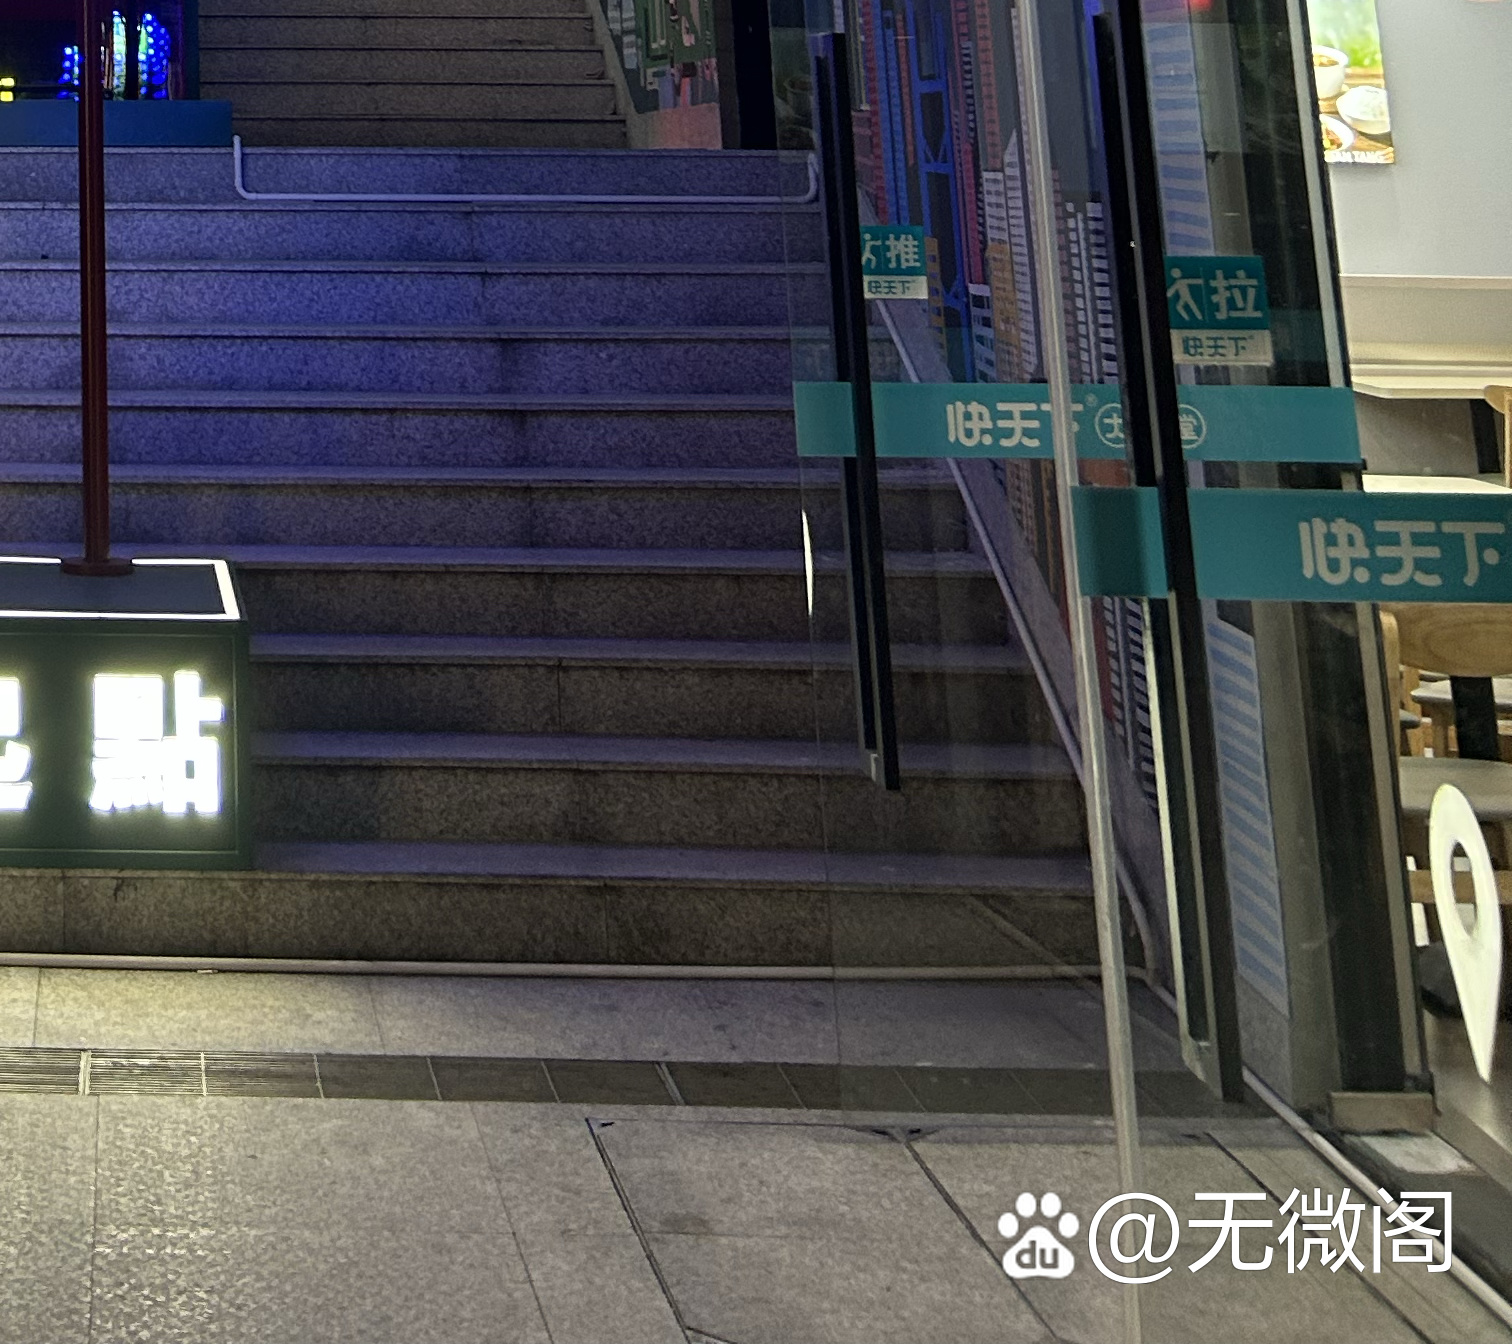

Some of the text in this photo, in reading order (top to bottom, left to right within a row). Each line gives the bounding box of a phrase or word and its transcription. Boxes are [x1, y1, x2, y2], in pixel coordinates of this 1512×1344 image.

[886, 234, 921, 269] 推
[1210, 269, 1263, 319] 拉
[1298, 518, 1505, 587] 快天下
